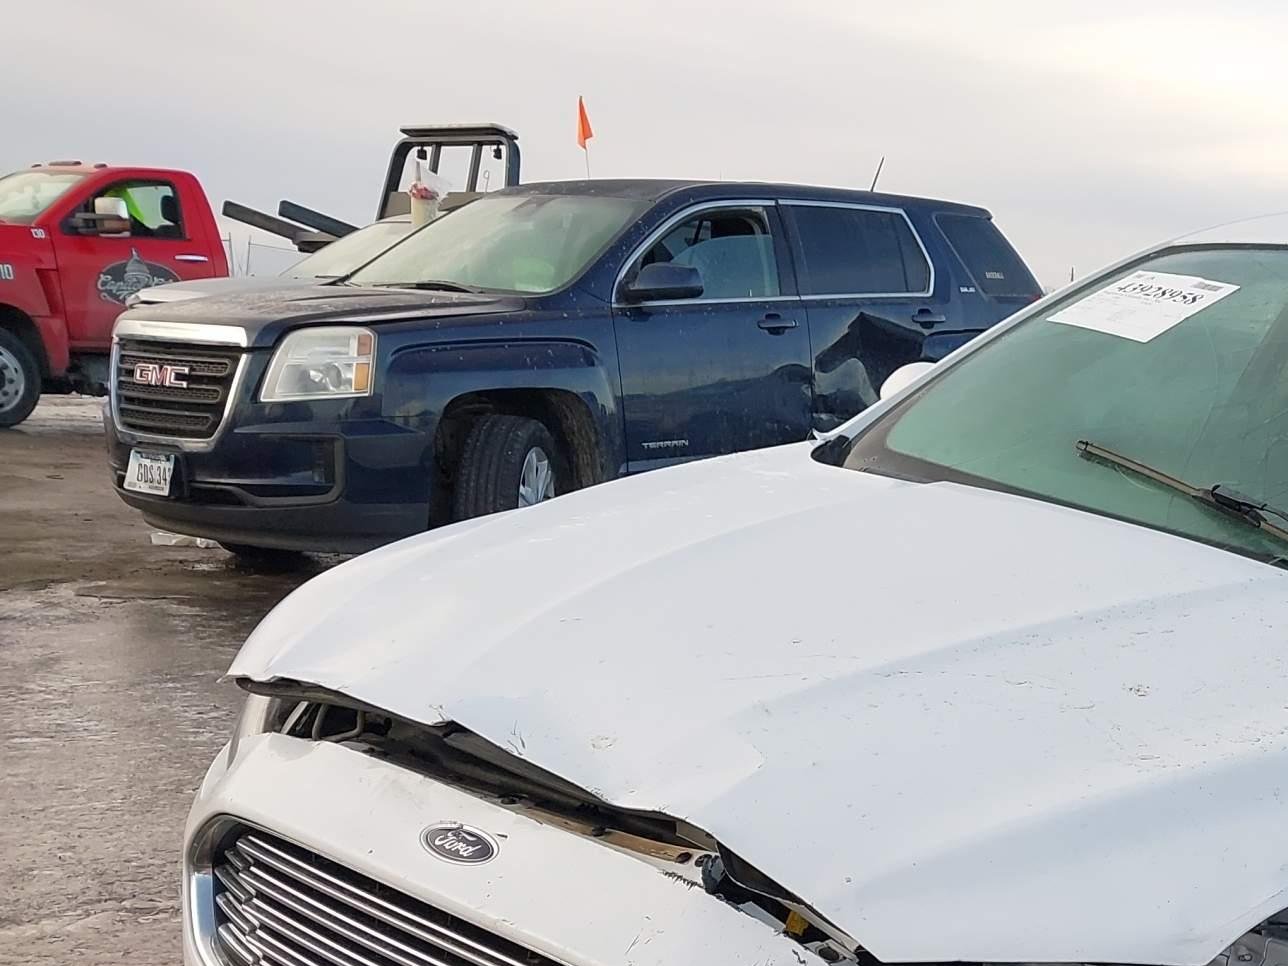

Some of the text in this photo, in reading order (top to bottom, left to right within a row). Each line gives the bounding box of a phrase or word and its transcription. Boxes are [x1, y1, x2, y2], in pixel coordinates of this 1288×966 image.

[1117, 281, 1204, 305] 43928958
[134, 363, 190, 388] GMC
[641, 440, 689, 449] TERRAIN
[434, 829, 482, 857] Ford
